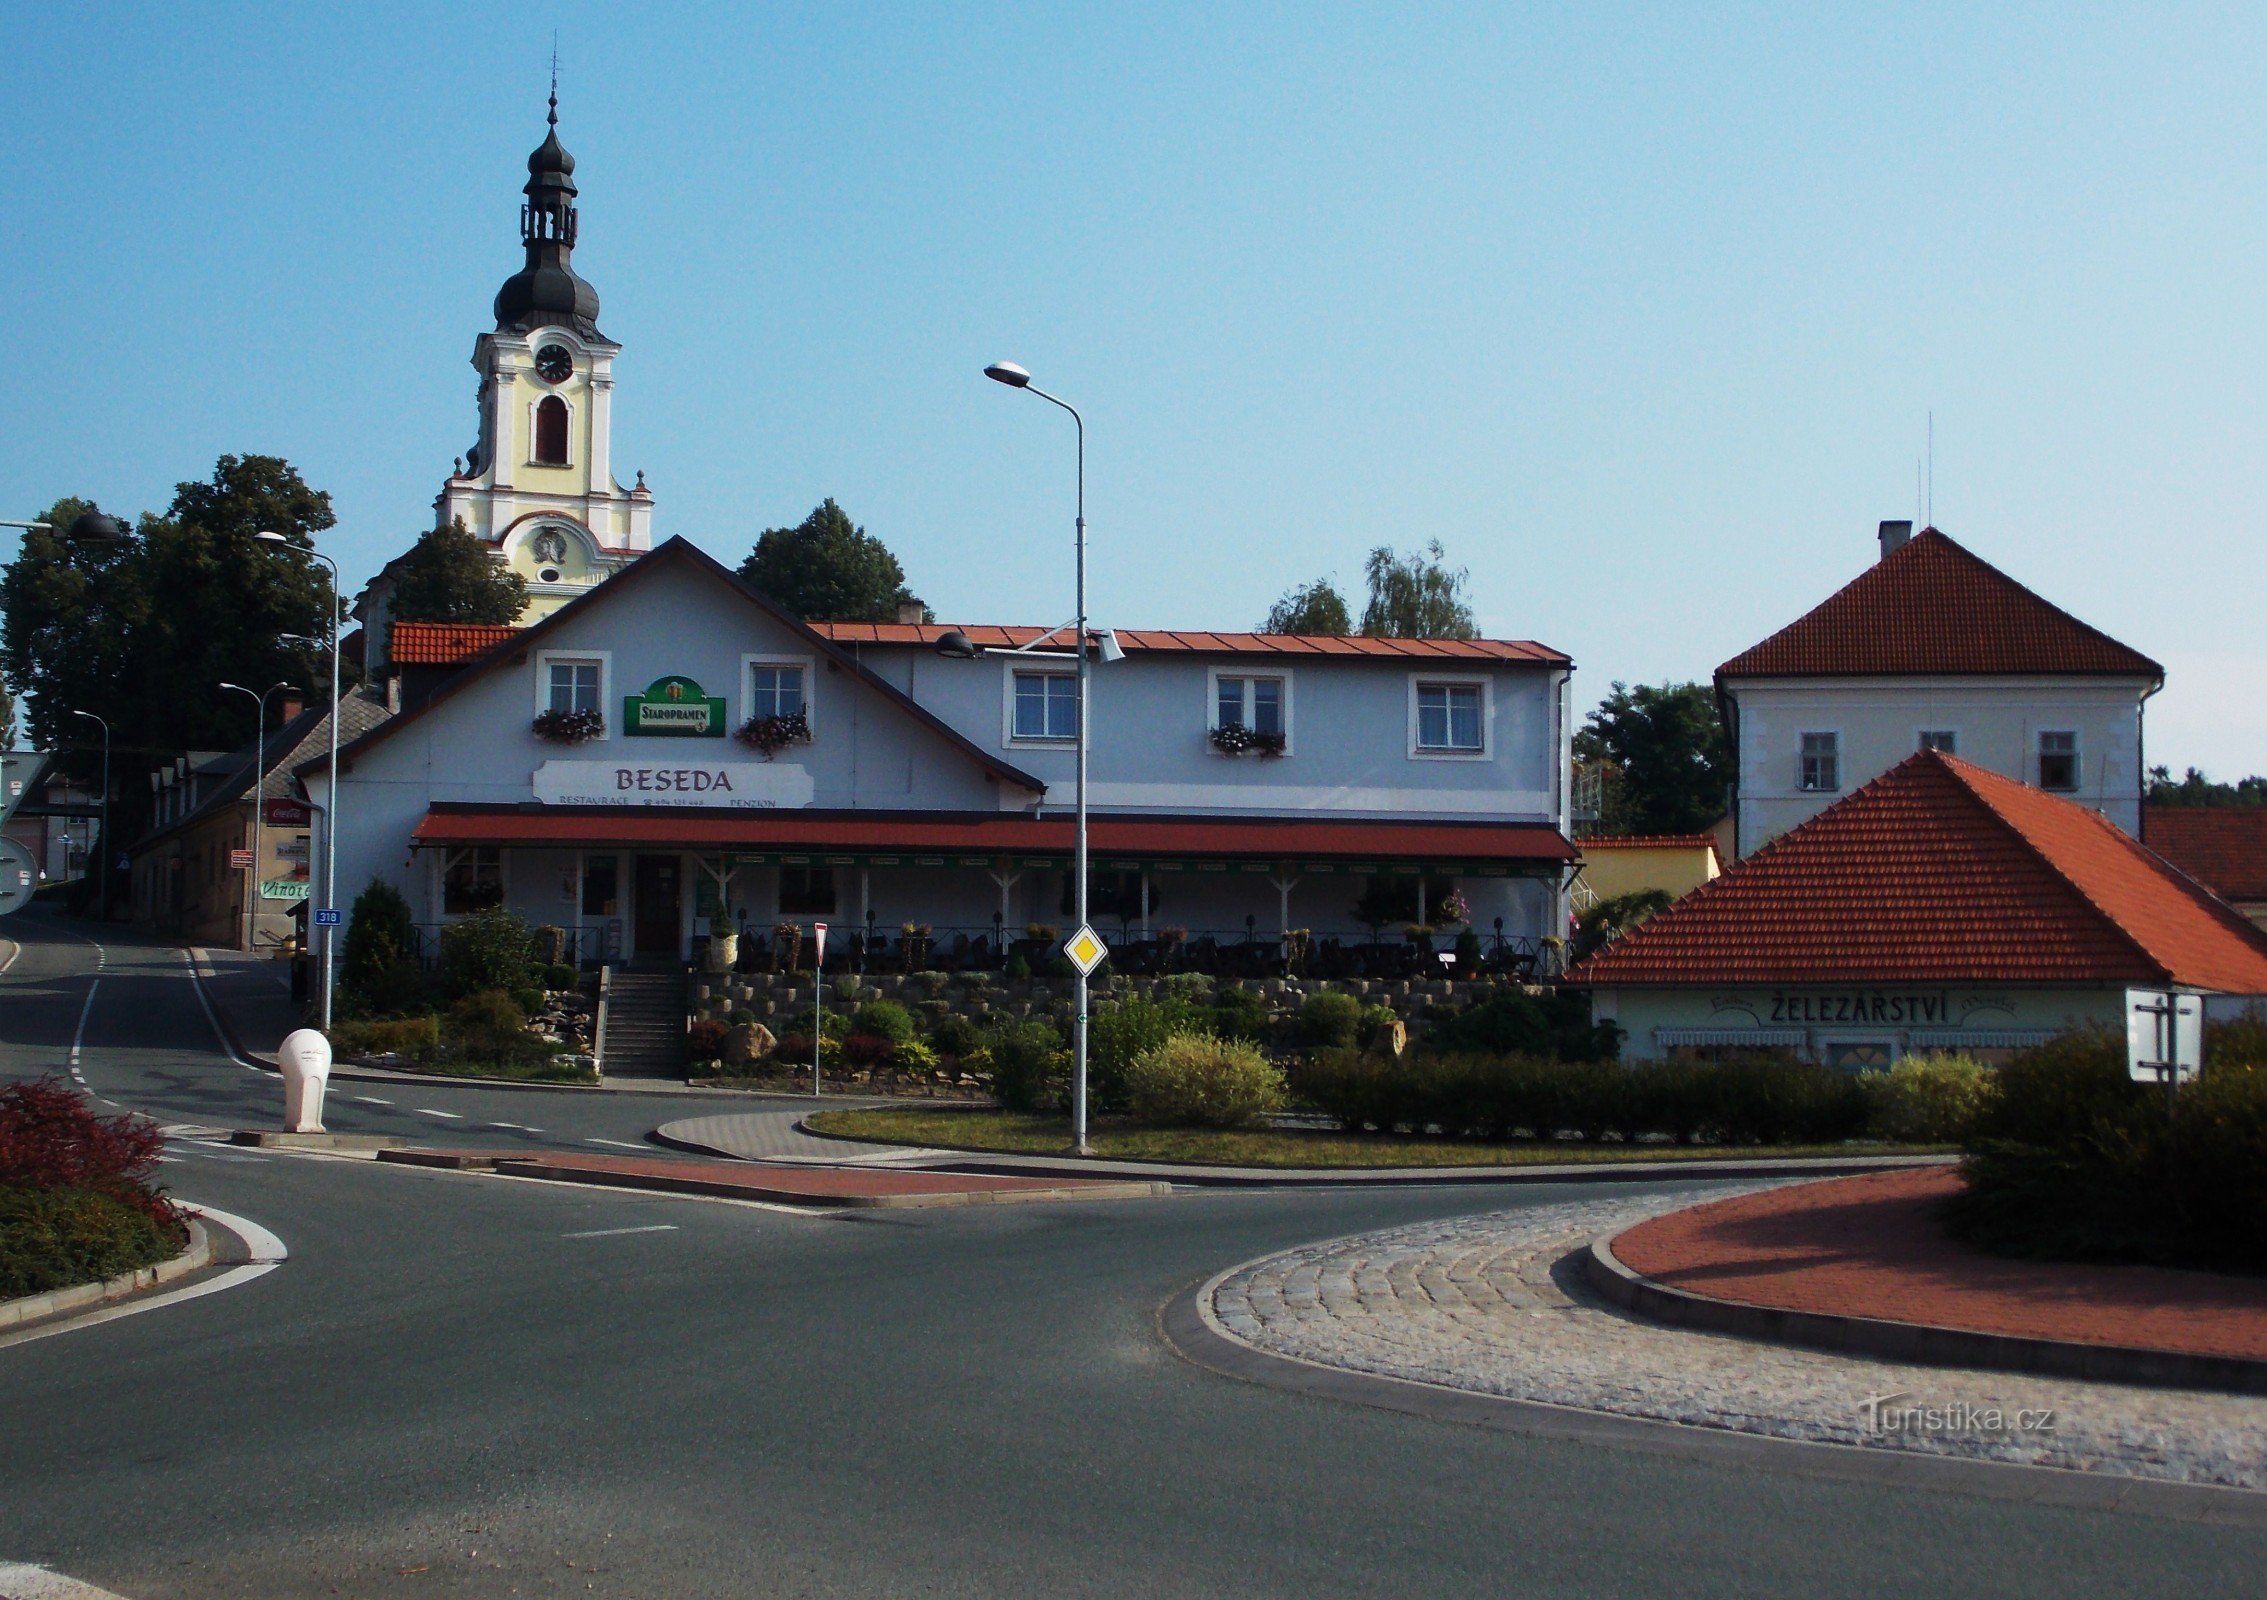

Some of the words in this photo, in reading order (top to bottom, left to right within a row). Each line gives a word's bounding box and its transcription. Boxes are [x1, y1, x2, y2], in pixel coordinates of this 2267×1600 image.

[642, 706, 707, 720] STAROPRAMEN
[615, 768, 733, 792] BESEDA
[559, 795, 629, 805] RESTAURACE
[729, 799, 776, 808] PENZION
[319, 912, 337, 922] 318
[1769, 988, 1948, 1022] ŽELEZÁŘSTVÍ
